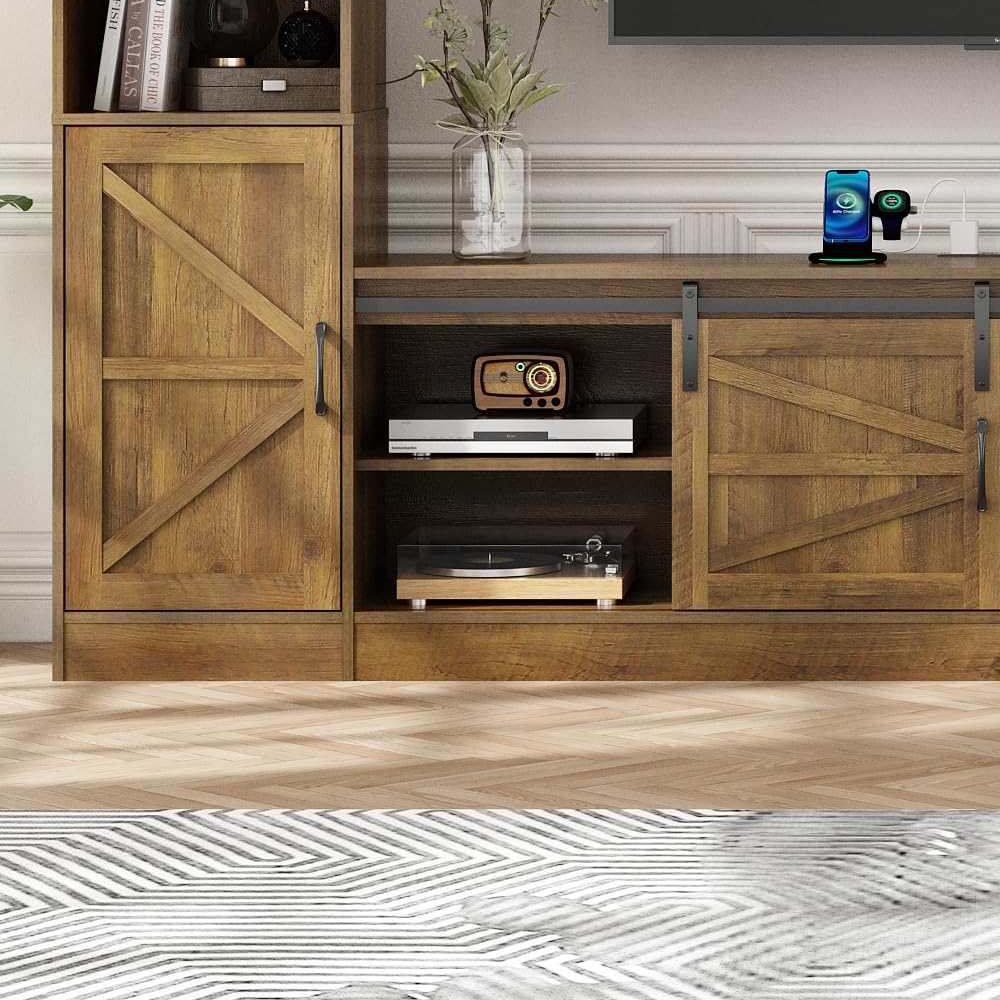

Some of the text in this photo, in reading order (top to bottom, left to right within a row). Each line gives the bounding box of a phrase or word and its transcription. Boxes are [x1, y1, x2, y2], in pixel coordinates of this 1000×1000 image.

[131, 11, 141, 20] by
[153, 9, 164, 30] THE
[150, 33, 163, 60] BOOK
[124, 26, 143, 97] CALLAS
[149, 63, 159, 77] OF
[146, 79, 158, 104] CHIC
